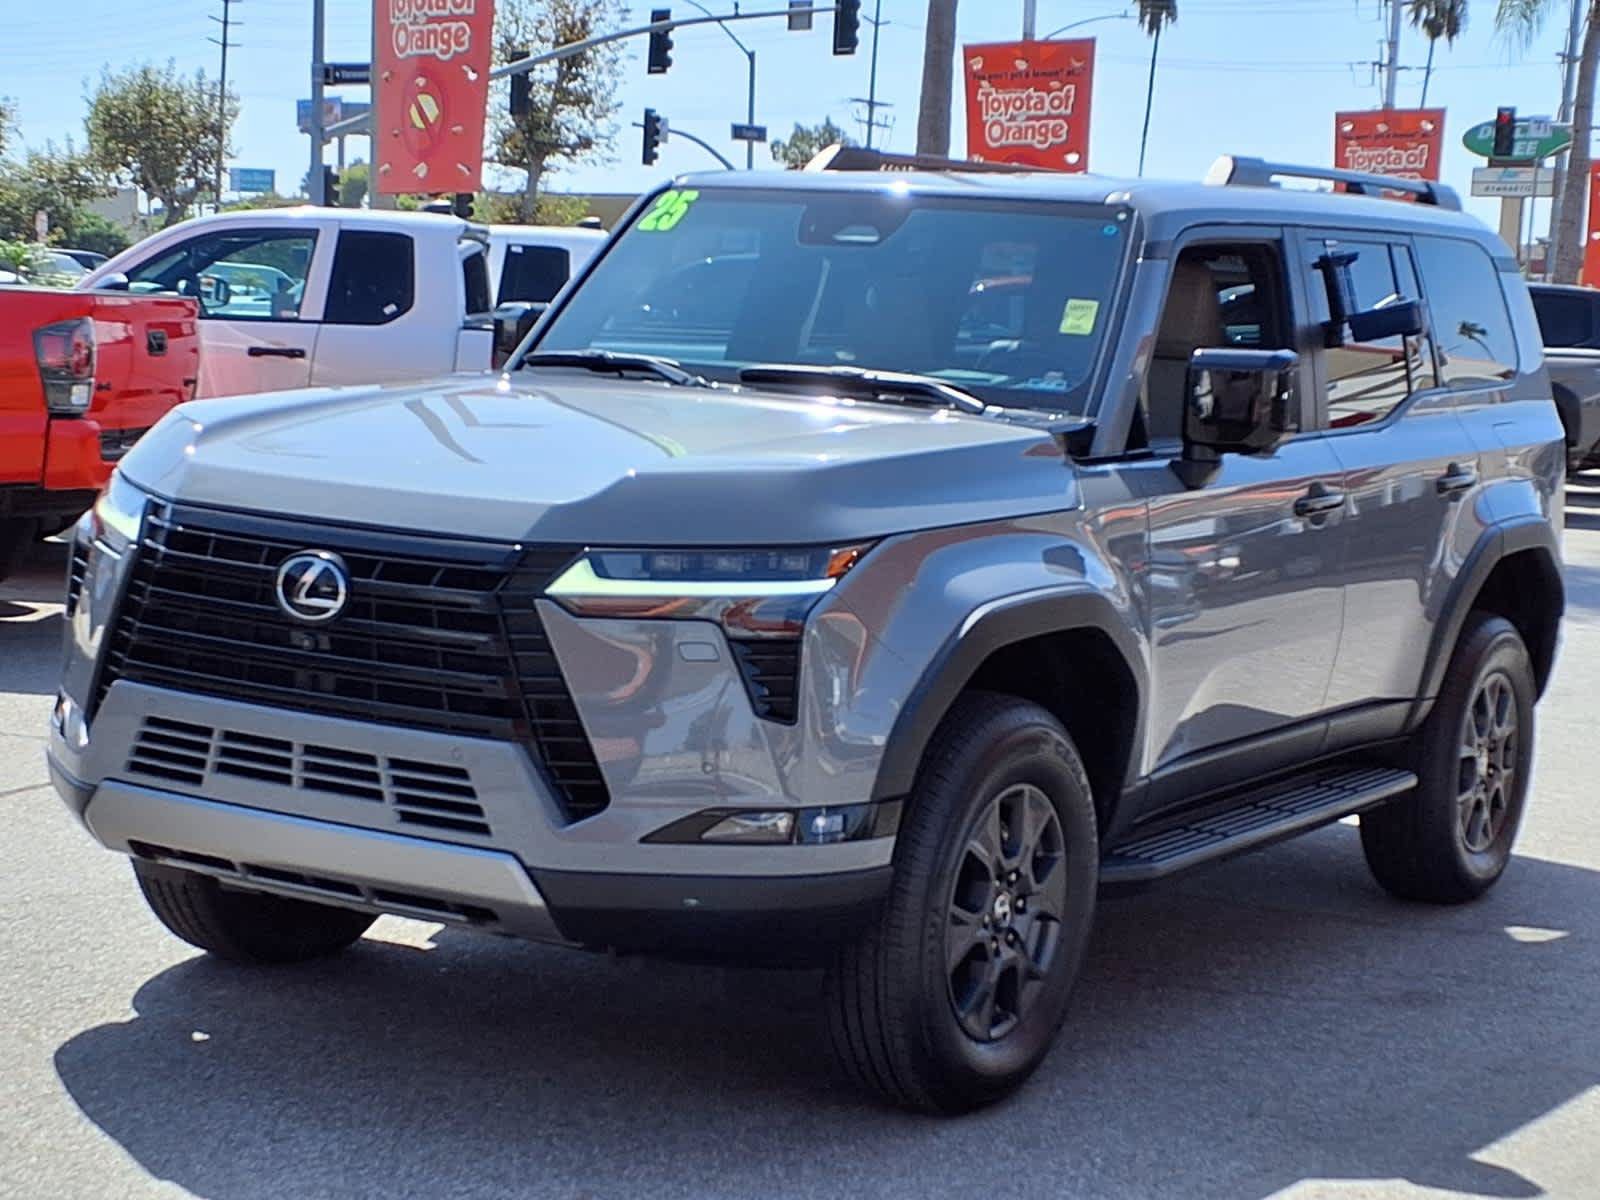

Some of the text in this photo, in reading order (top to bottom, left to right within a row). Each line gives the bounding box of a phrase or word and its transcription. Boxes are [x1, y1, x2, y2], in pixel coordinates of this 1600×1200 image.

[392, 21, 471, 61] Orange
[977, 84, 1075, 121] Toyota of
[985, 118, 1068, 150] Orange
[1344, 143, 1430, 173] Toyota of
[637, 189, 699, 231] 25
